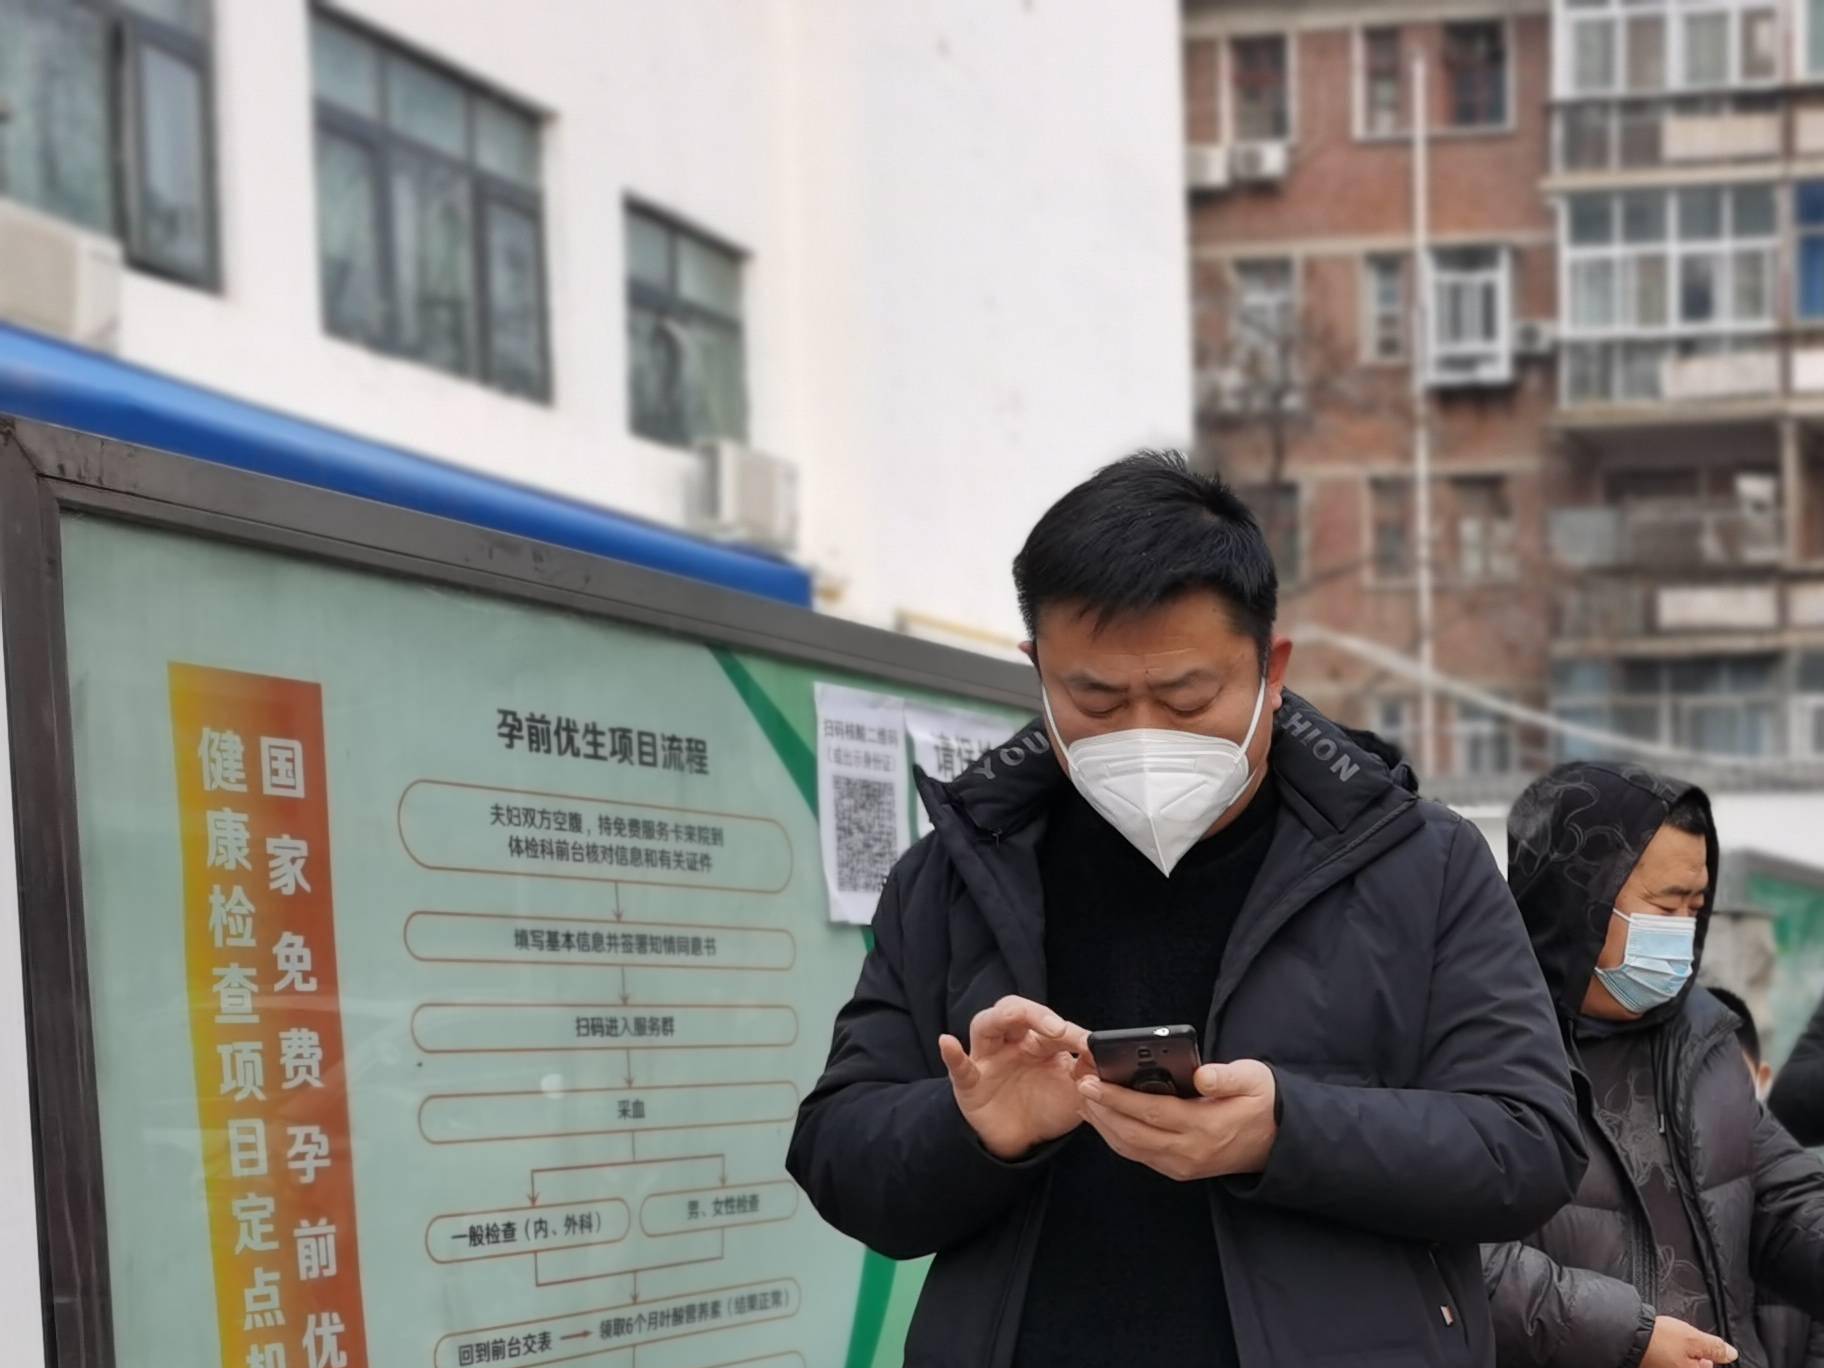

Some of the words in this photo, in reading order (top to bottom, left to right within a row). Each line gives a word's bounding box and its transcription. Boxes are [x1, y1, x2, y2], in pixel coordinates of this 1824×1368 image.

[497, 708, 710, 775] 孕前优生项目流程
[507, 834, 713, 873] 体检科前台核对信息和有关证件
[575, 1015, 676, 1038] 扫码进入服务群
[617, 1098, 647, 1121] 采血
[458, 1330, 553, 1367] 回到前台交表
